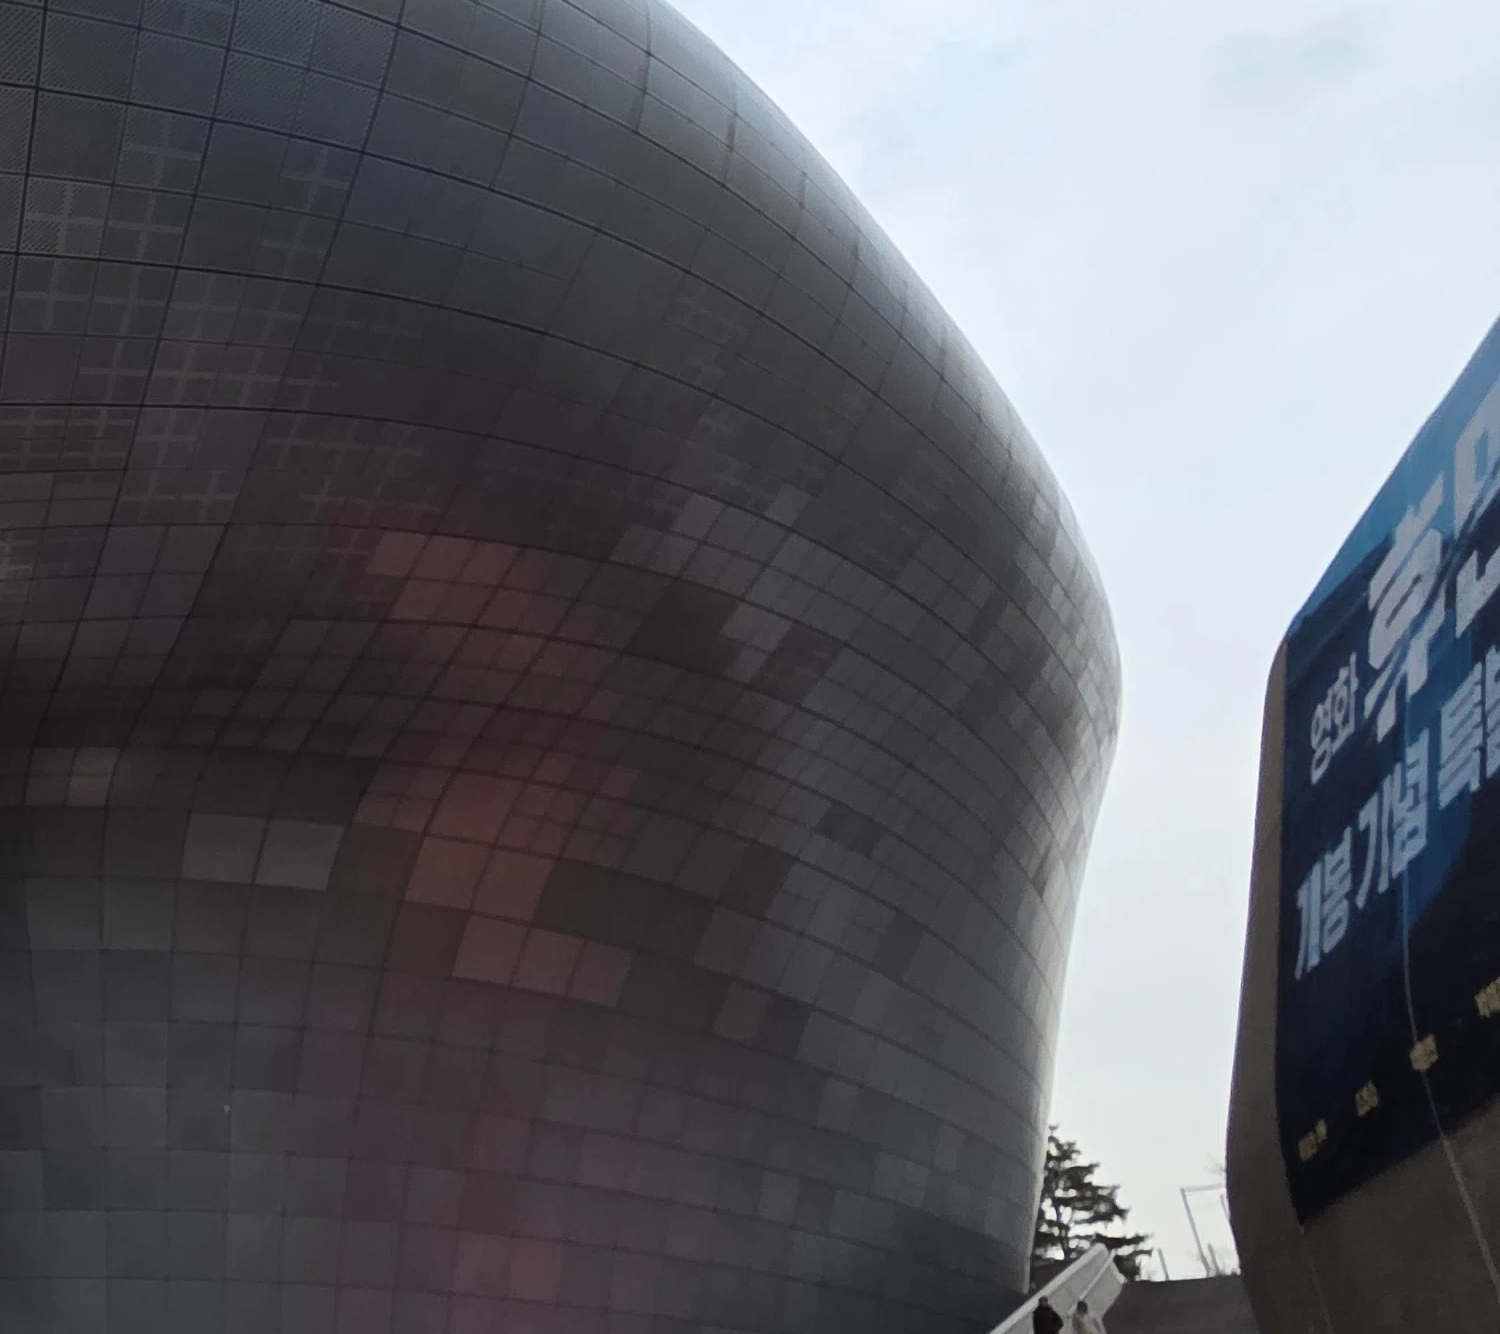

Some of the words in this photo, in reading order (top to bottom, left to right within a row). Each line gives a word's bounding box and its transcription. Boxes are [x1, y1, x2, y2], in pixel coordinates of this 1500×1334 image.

[1294, 825, 1352, 981] 개봉
[1355, 727, 1430, 910] 기념
[1437, 642, 1500, 810] 특
[1310, 651, 1359, 785] 영화
